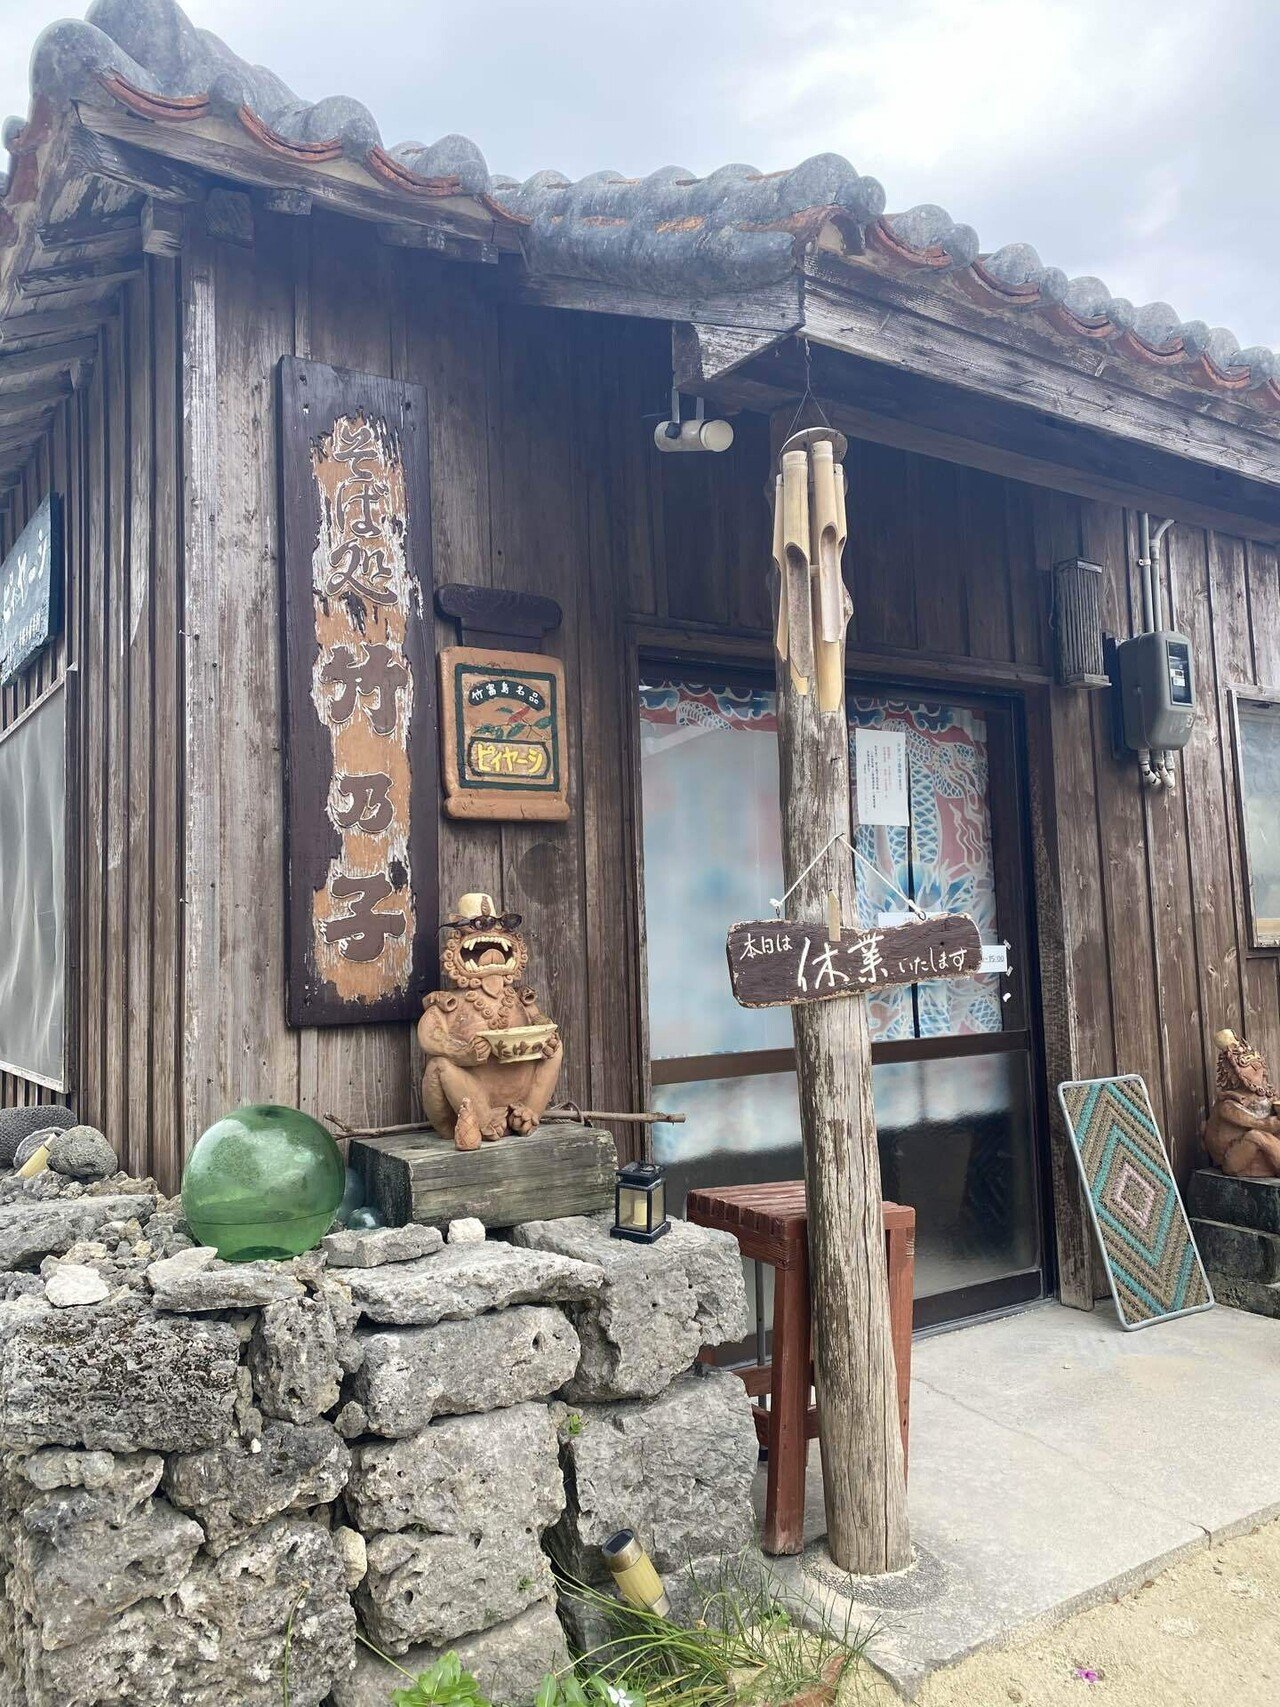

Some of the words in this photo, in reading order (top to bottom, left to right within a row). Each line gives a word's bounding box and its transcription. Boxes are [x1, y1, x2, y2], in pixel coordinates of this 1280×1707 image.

[327, 423, 399, 606] そば処
[472, 682, 539, 704] 竹富島名品
[316, 642, 410, 963] 竹乃子
[740, 933, 793, 960] 本日は
[797, 931, 888, 991] 休業
[899, 947, 967, 972] いたします
